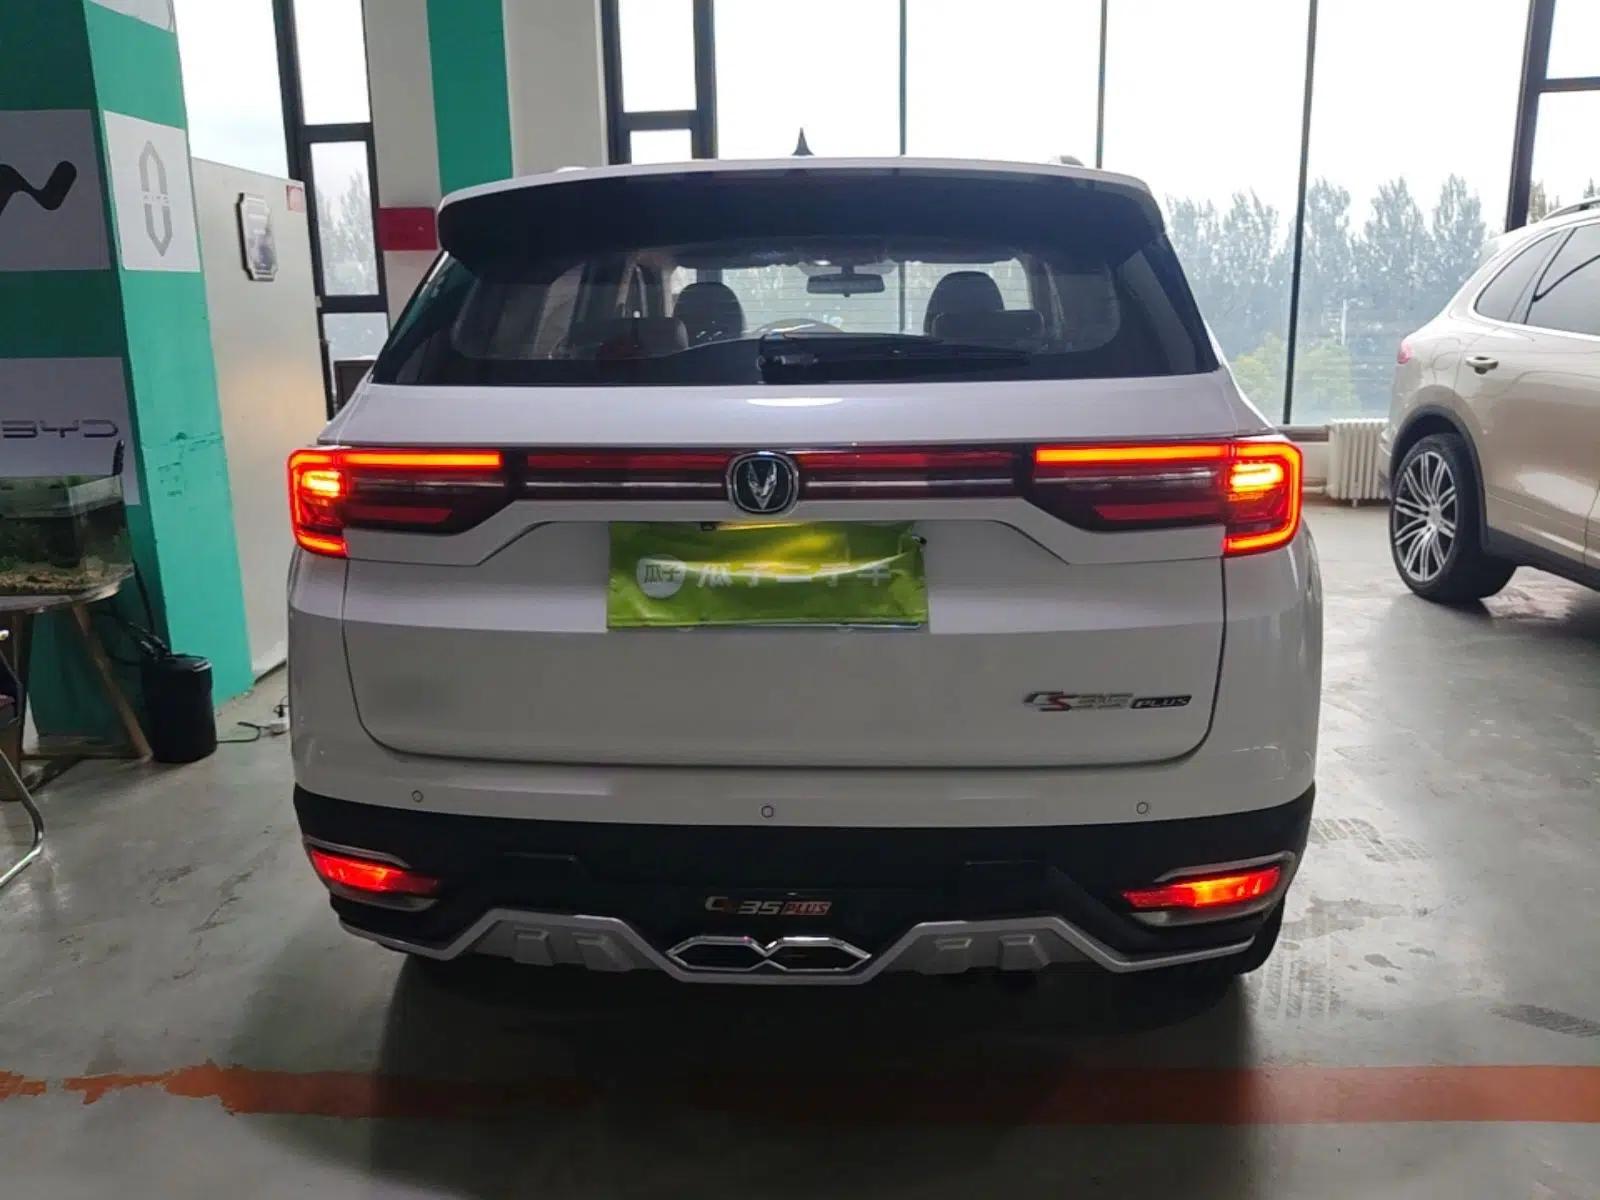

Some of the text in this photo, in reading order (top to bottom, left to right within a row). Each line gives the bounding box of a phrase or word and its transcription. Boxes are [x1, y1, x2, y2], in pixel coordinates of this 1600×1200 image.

[1, 419, 119, 438] BYD
[1131, 695, 1192, 709] PLUS
[705, 896, 783, 914] C35
